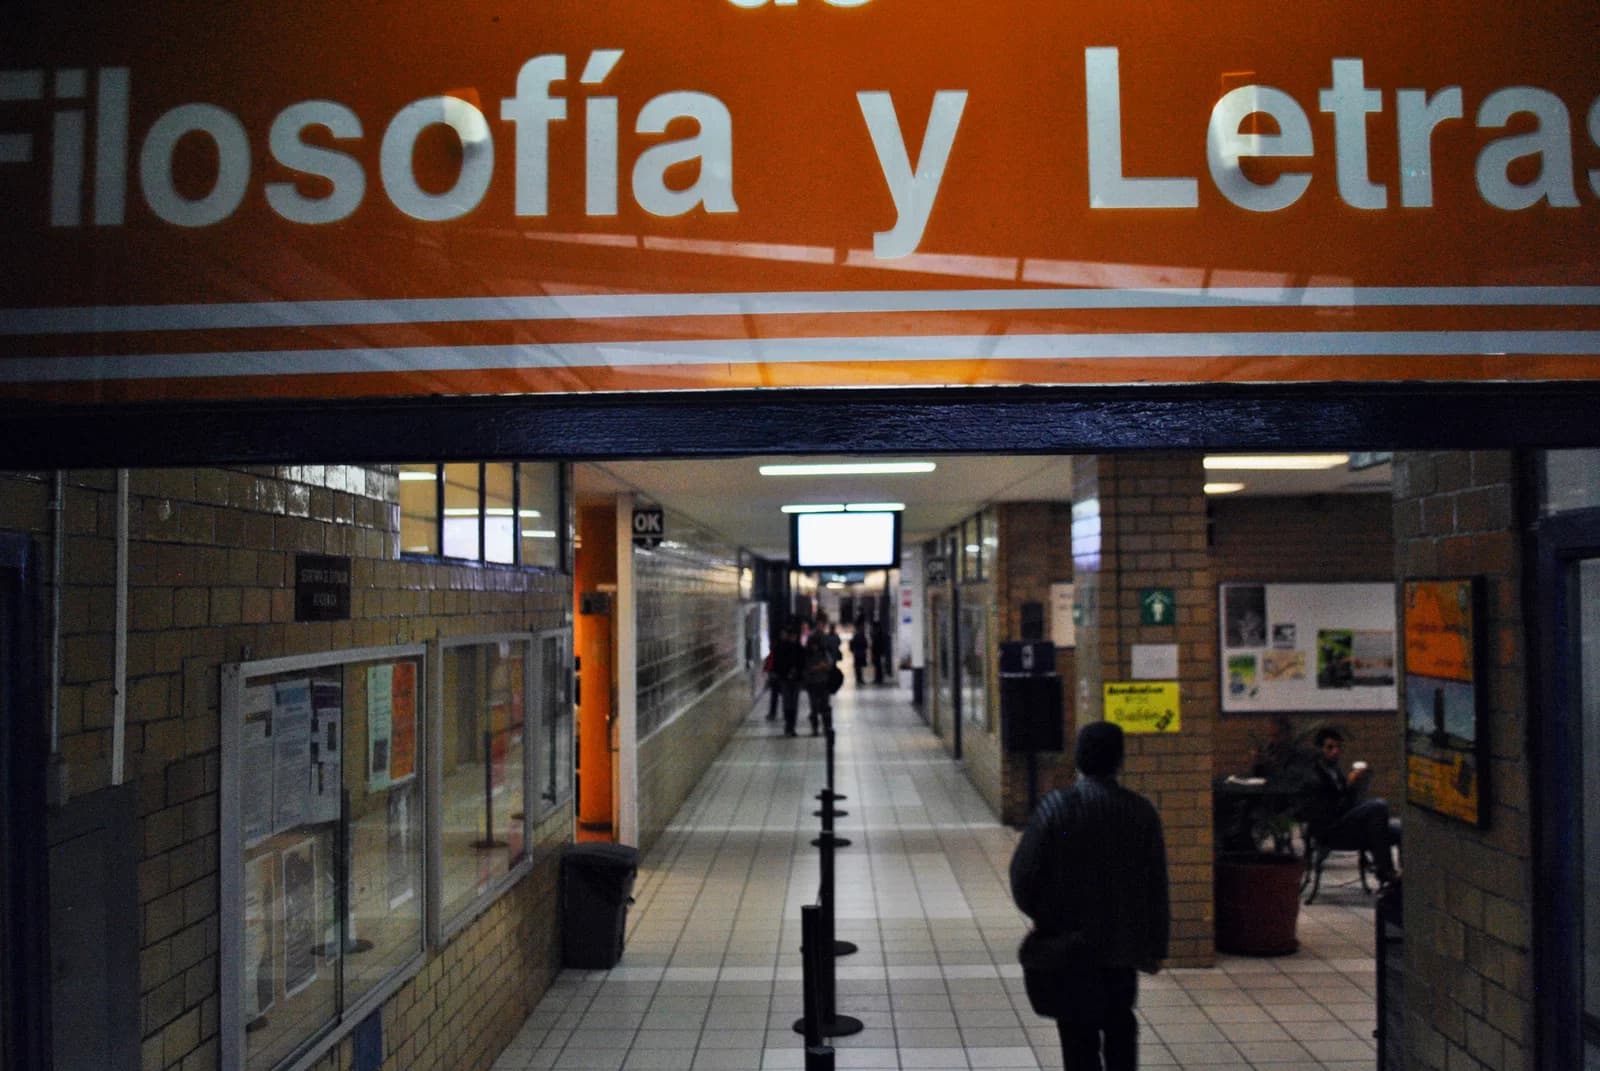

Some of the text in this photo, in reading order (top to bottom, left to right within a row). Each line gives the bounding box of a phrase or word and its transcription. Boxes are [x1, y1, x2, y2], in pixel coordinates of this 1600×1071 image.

[856, 88, 969, 260] y
[1084, 45, 1600, 213] Letra
[634, 513, 661, 532] OK
